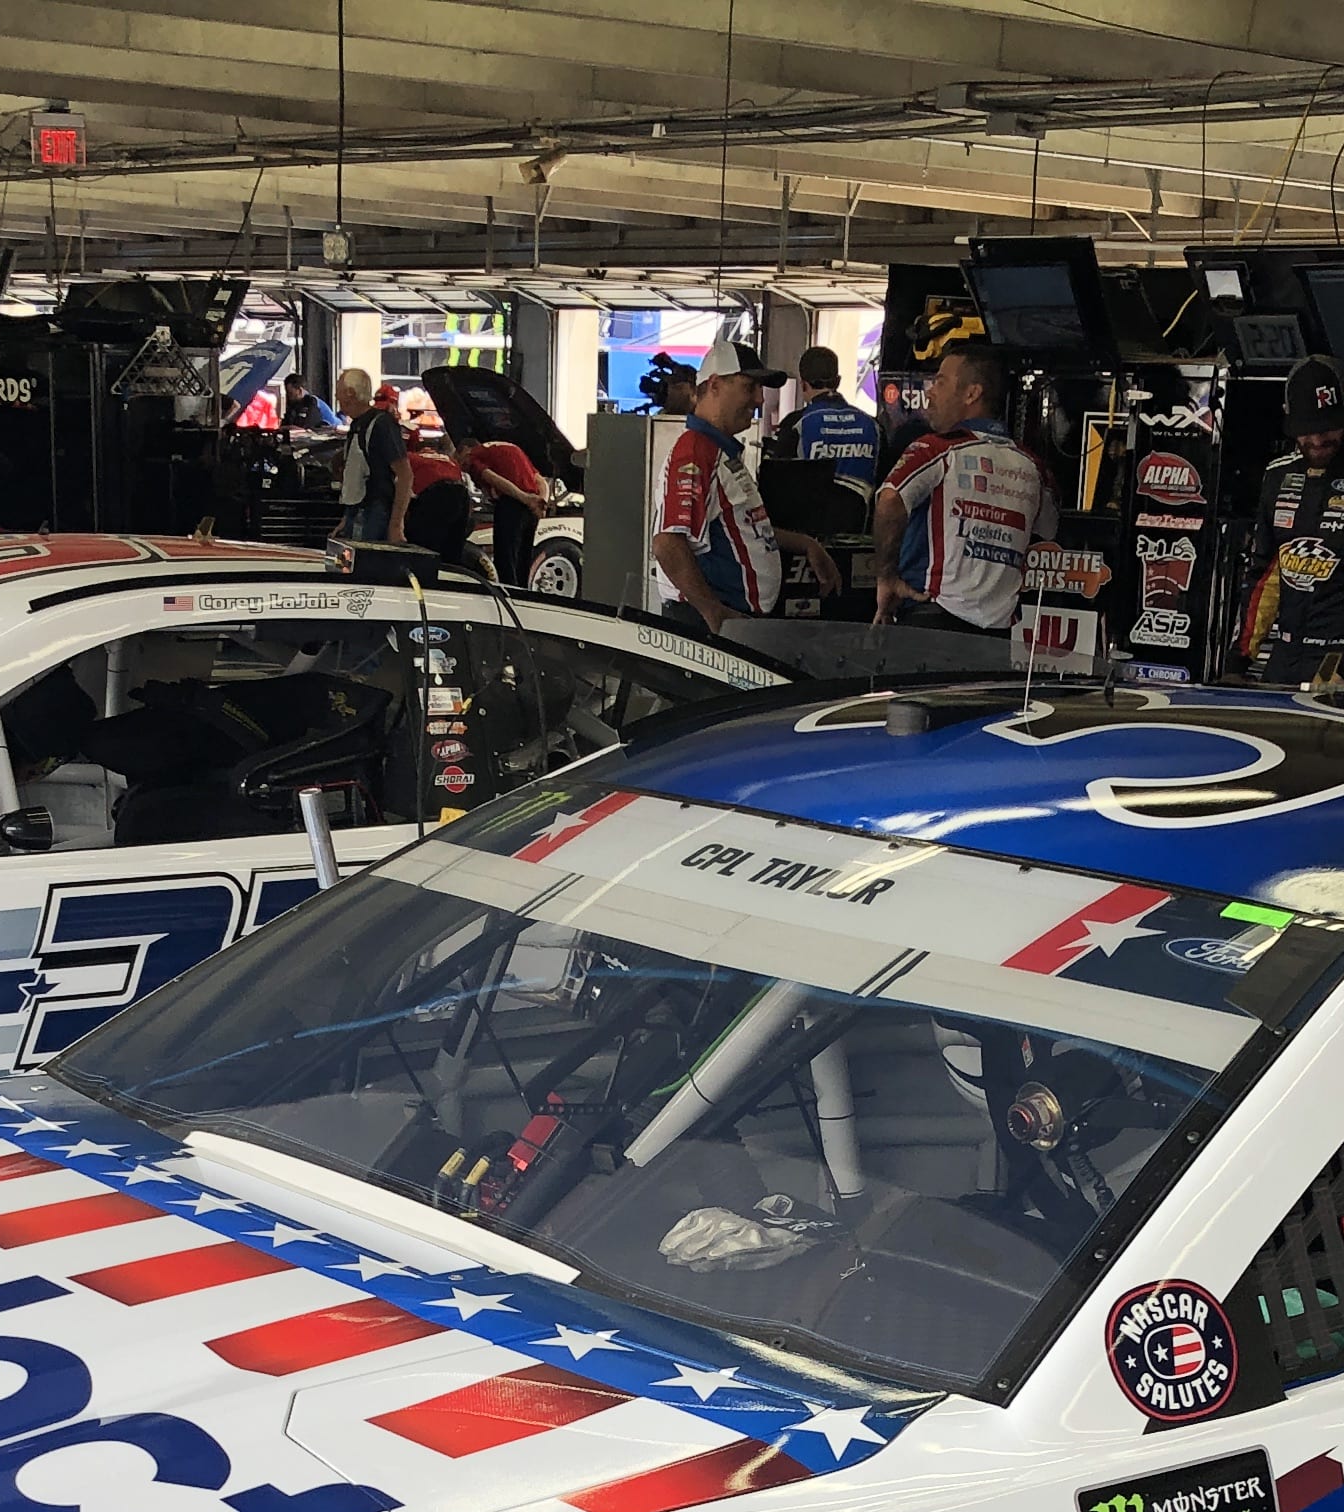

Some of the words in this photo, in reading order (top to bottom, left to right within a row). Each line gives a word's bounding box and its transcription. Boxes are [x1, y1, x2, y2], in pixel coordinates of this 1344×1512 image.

[40, 129, 77, 163] EXIT
[809, 440, 874, 460] FASTENAL
[1143, 465, 1190, 486] ALPHA
[951, 497, 1007, 521] Superior
[955, 517, 1014, 543] Logistics
[1024, 552, 1102, 571] ORVETTE
[1023, 569, 1066, 590] ARTS
[199, 594, 264, 614] Corey
[269, 592, 341, 611] LaJoie
[637, 624, 726, 671] SOUTHERN
[726, 656, 774, 687] PRIDE
[436, 775, 474, 785] SHORAI
[679, 842, 754, 880] CPL
[755, 855, 896, 906] TAYLOR
[1121, 1292, 1210, 1348] NASCAR
[1134, 1358, 1233, 1413] SALUTES
